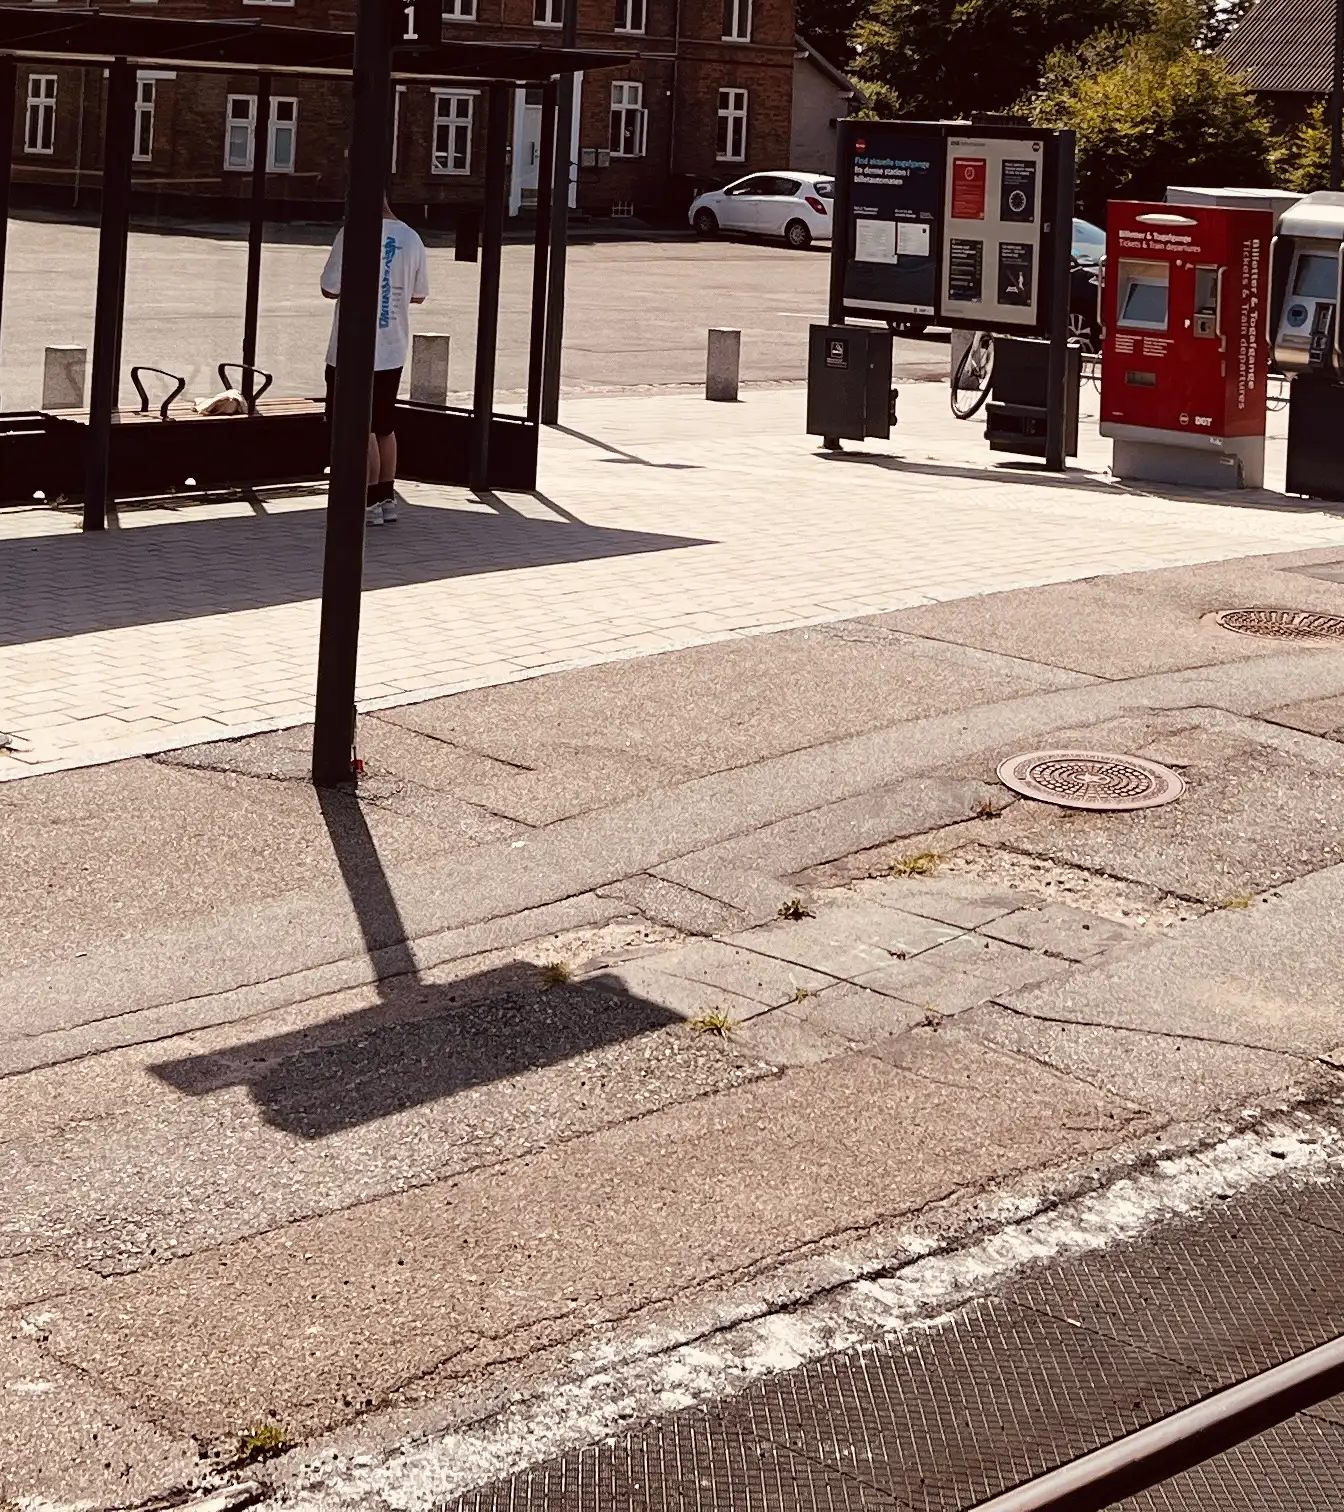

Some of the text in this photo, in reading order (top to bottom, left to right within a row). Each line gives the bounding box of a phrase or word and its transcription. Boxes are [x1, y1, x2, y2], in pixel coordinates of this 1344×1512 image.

[403, 6, 419, 40] 1
[1242, 240, 1252, 285] Tickets
[1240, 303, 1250, 335] Train
[1247, 239, 1260, 389] Billetter & Togafgange
[1238, 338, 1248, 409] departures
